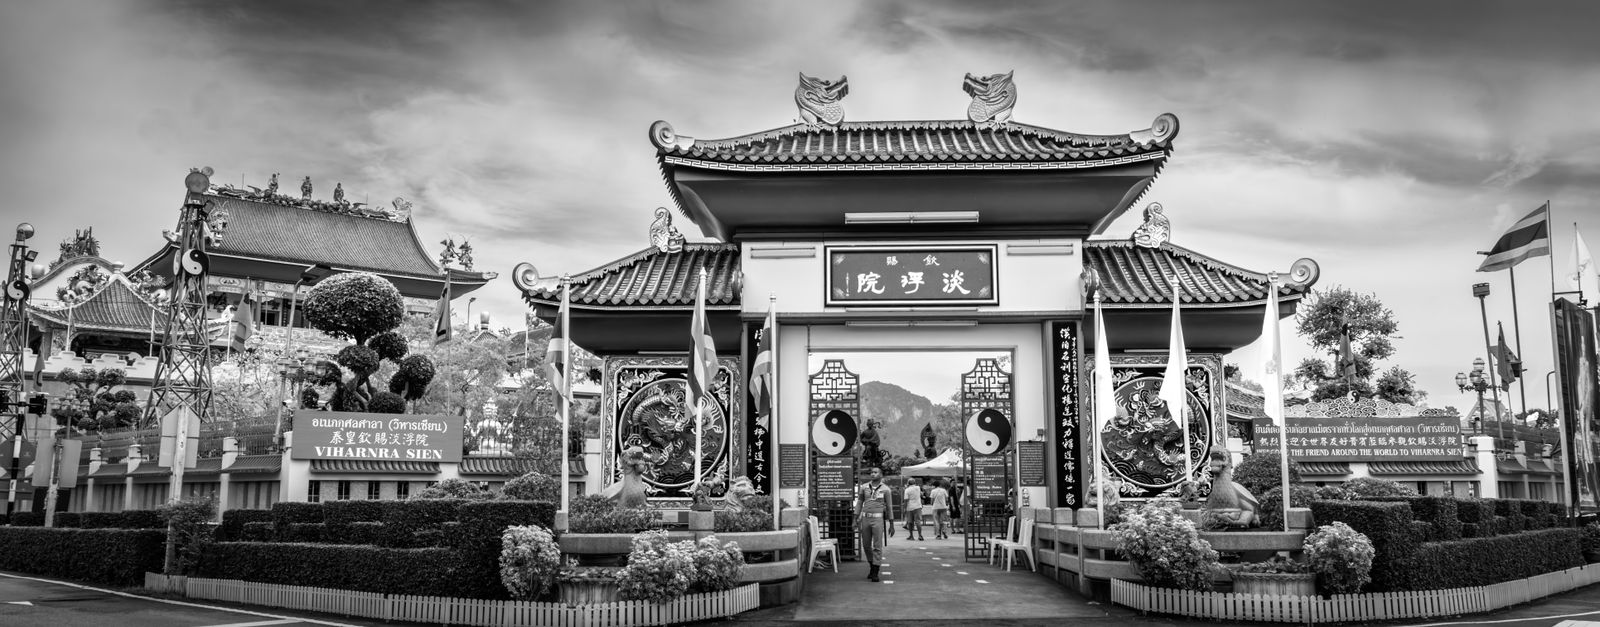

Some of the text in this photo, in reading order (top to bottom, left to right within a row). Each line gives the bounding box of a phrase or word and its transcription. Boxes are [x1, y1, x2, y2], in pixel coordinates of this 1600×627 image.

[329, 431, 429, 447] 泰皇欽賜淡浮院
[315, 446, 443, 460] VIHARNRA SIEN
[1374, 448, 1398, 456] WORLD
[1400, 448, 1409, 456] TO
[1410, 448, 1445, 456] VIHARNRA
[1447, 448, 1462, 456] SIEN
